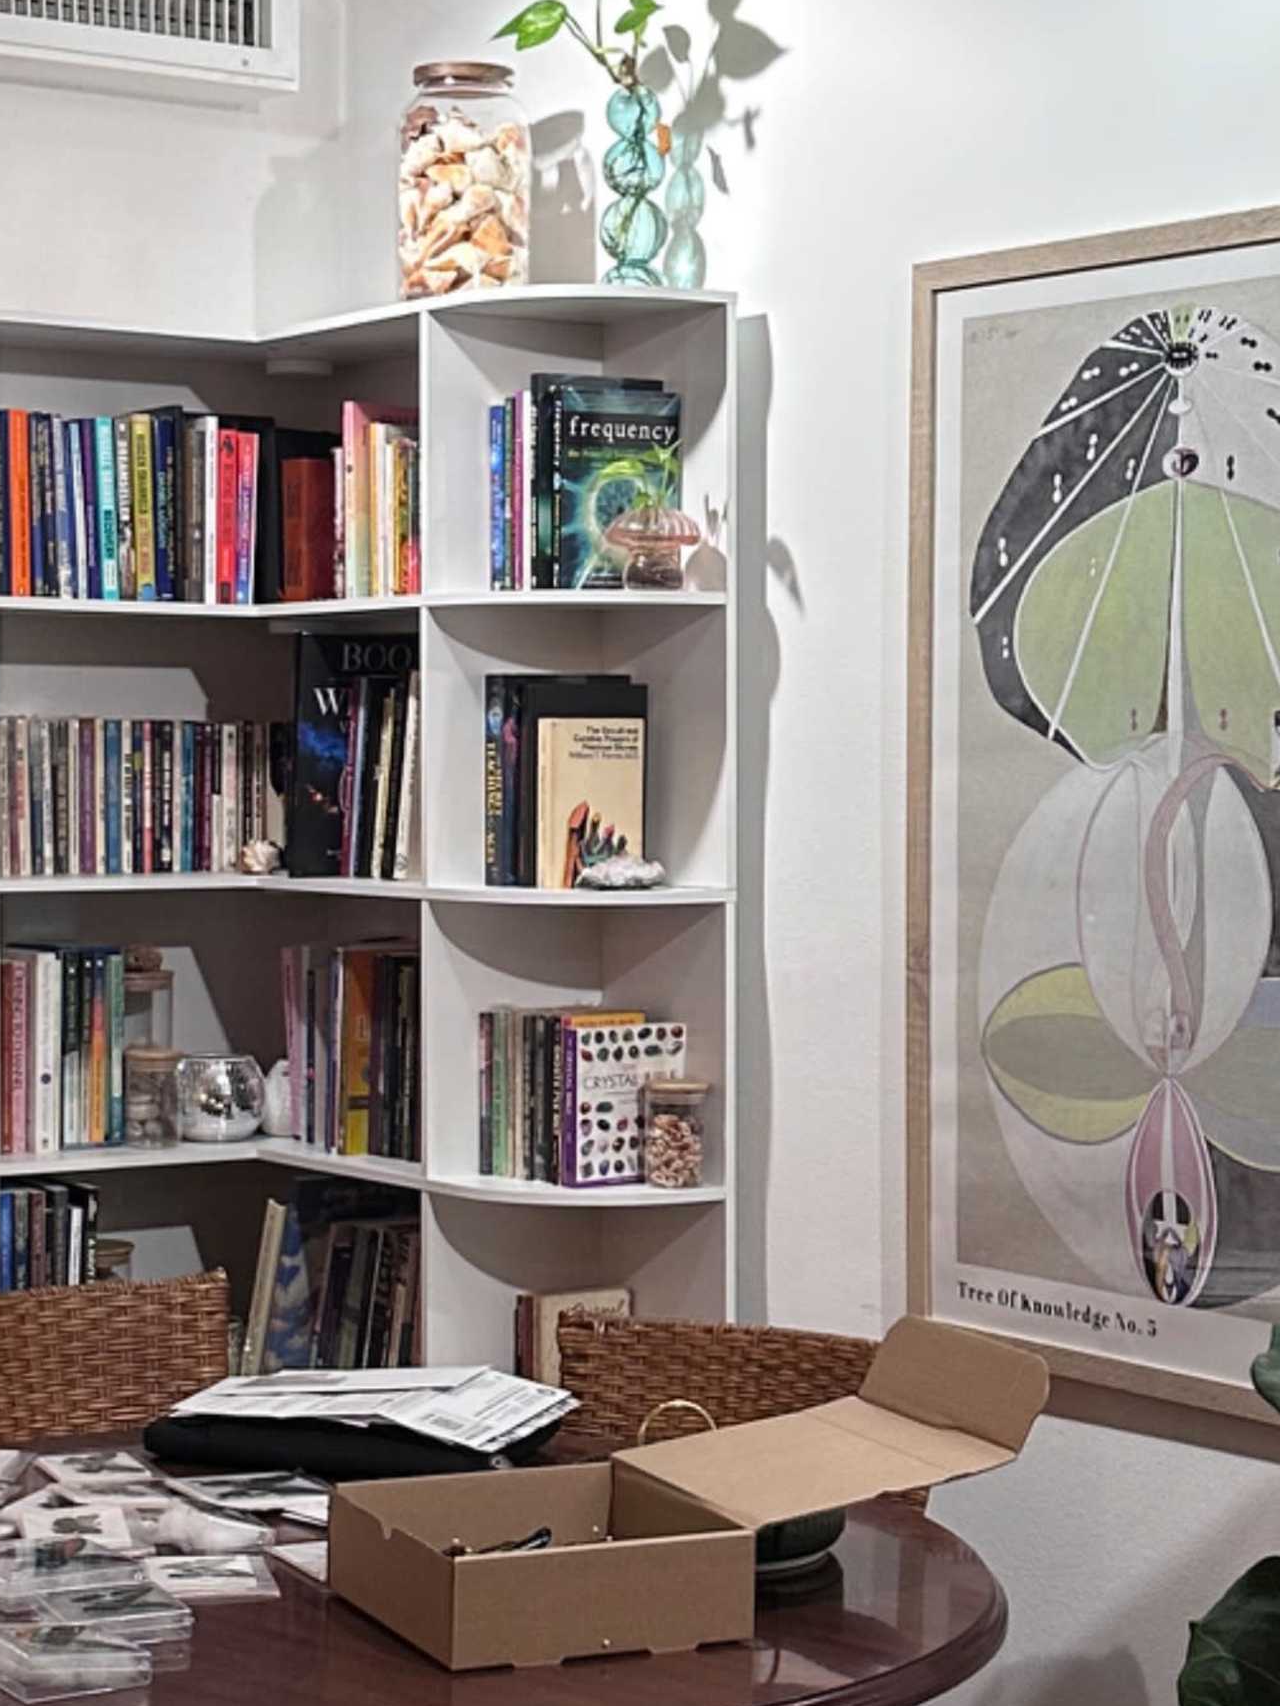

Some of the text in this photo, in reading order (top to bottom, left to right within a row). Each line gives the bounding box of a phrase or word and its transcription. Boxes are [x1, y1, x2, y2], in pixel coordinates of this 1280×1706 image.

[569, 415, 676, 445] frequency
[342, 643, 412, 671] BOO
[583, 1074, 638, 1090] CRYSTAL
[958, 1280, 1158, 1338] Tree Of Knowledge No. 5
